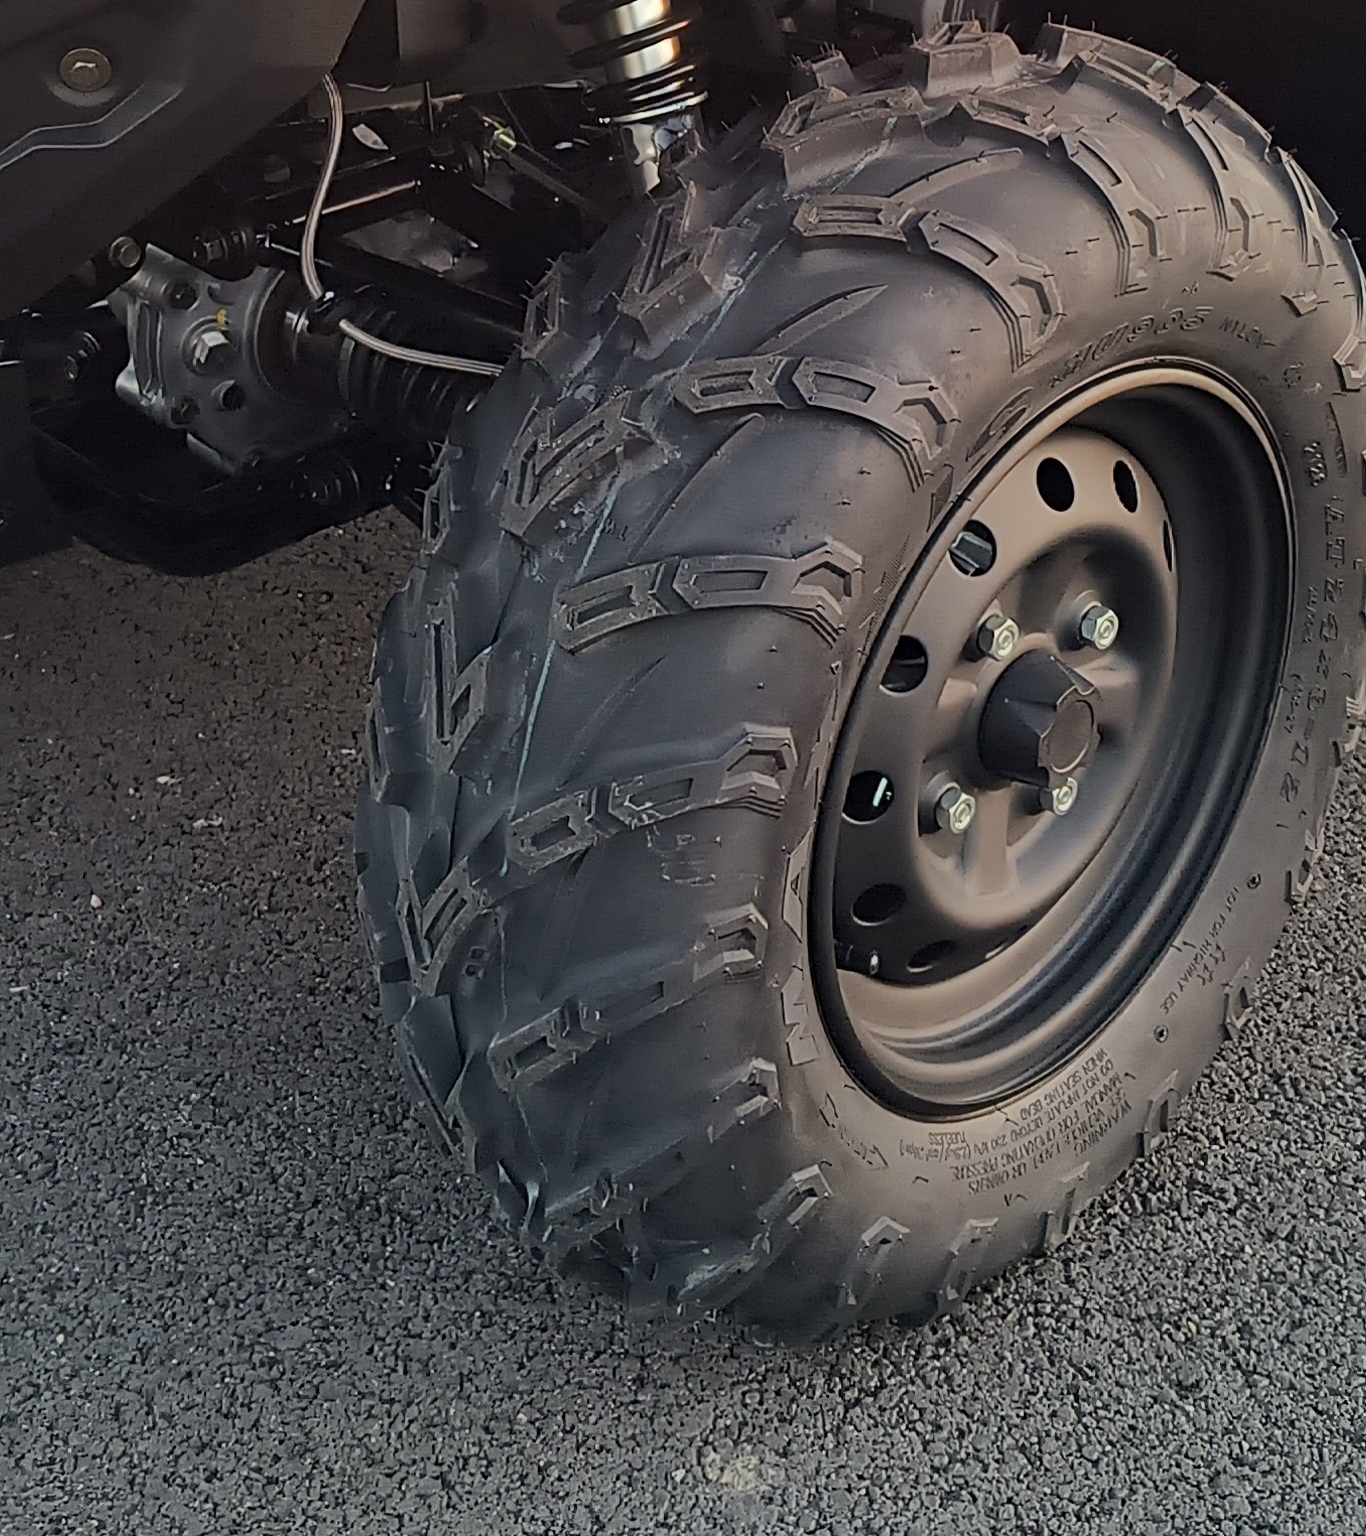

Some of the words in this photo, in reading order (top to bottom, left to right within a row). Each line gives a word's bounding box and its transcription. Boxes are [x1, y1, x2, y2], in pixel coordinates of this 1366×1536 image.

[1209, 913, 1226, 938] FOR
[1177, 938, 1211, 991] HIGHWAY
[1159, 991, 1178, 1014] USE
[1080, 1048, 1108, 1075] WHEN
[1043, 1070, 1082, 1105] SEATING
[1081, 1072, 1100, 1095] NOT
[1020, 1098, 1043, 1120] BEAD
[1044, 1089, 1080, 1122] INFLATE
[1057, 1109, 1080, 1133] FOR
[1071, 1099, 1132, 1157] WARNING
[929, 1131, 965, 1144] TUBELESS
